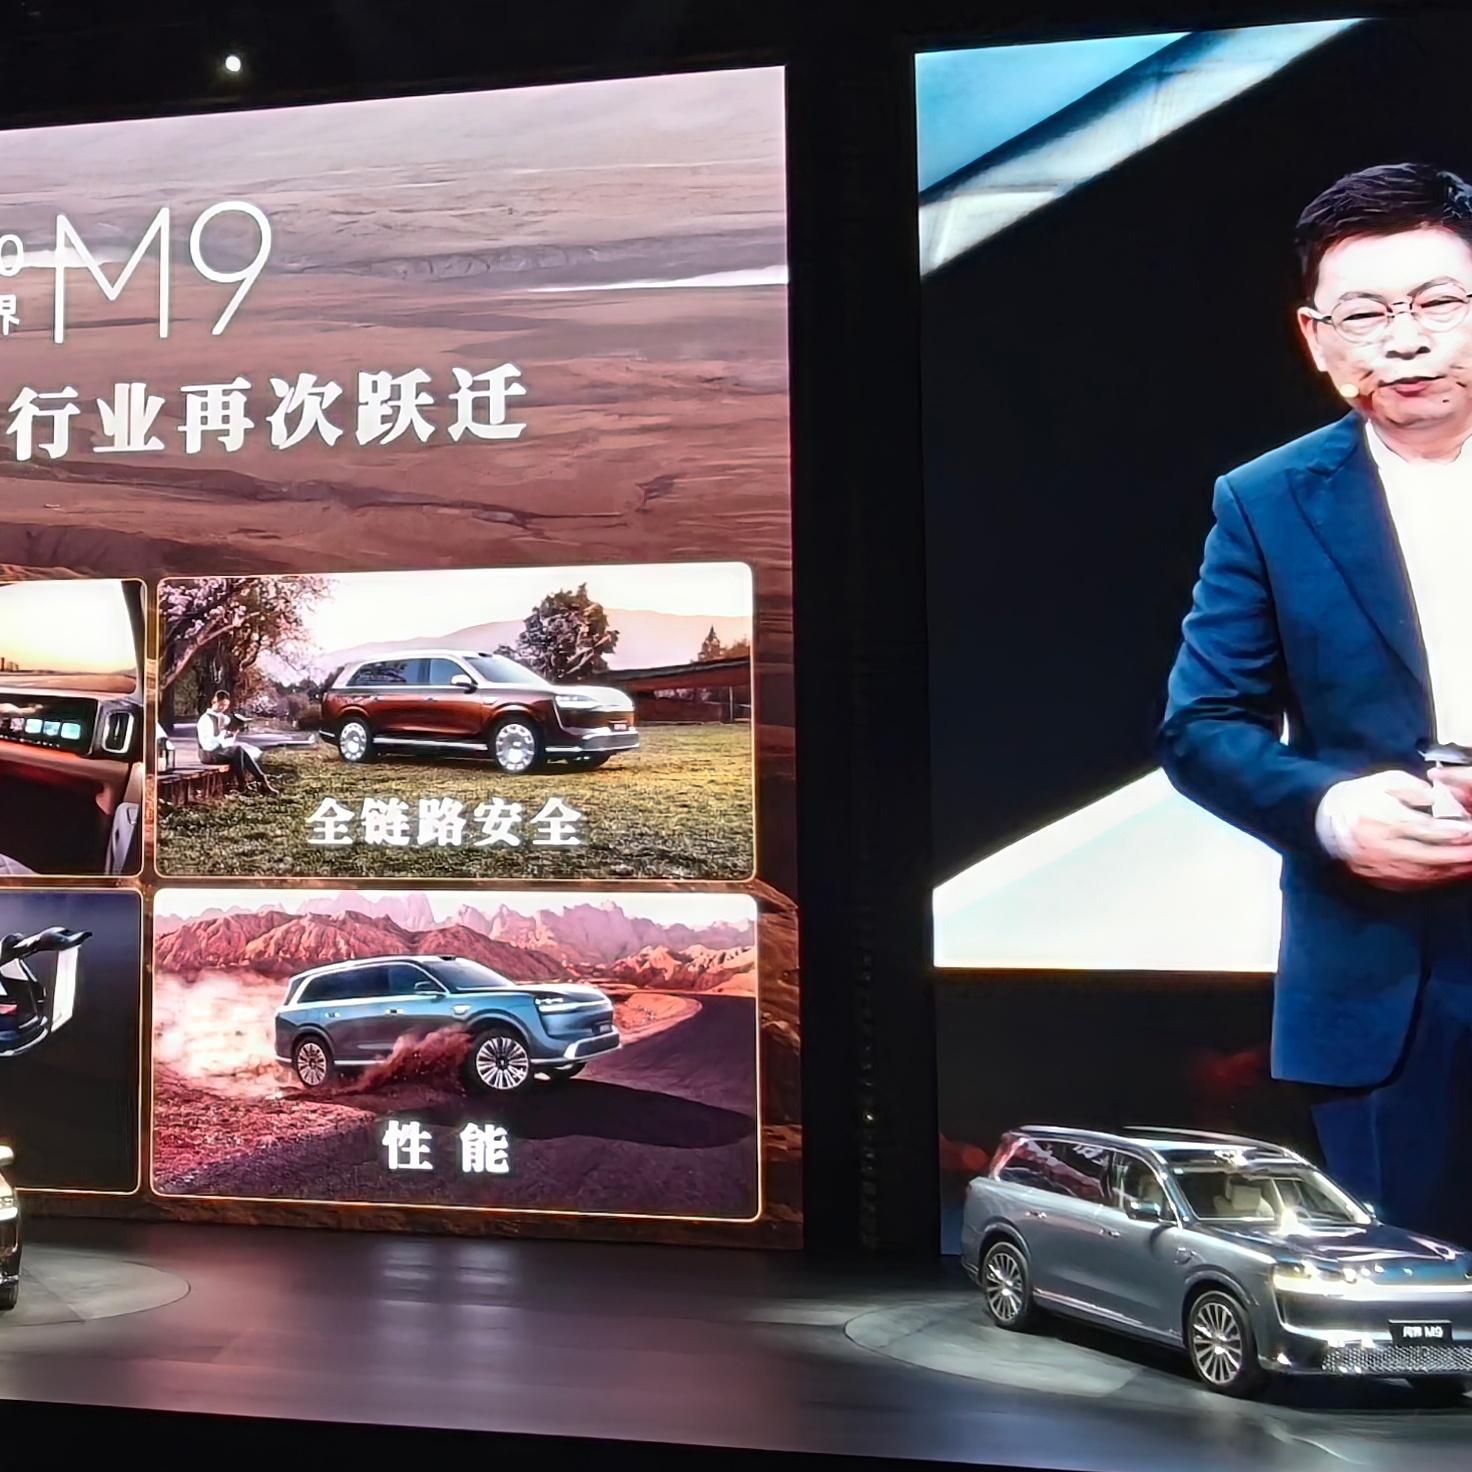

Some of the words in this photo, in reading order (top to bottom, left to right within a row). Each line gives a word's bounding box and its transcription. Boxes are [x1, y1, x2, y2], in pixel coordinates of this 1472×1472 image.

[54, 200, 272, 344] M9
[306, 797, 582, 847] 全链路安全
[381, 1120, 510, 1173] 性能
